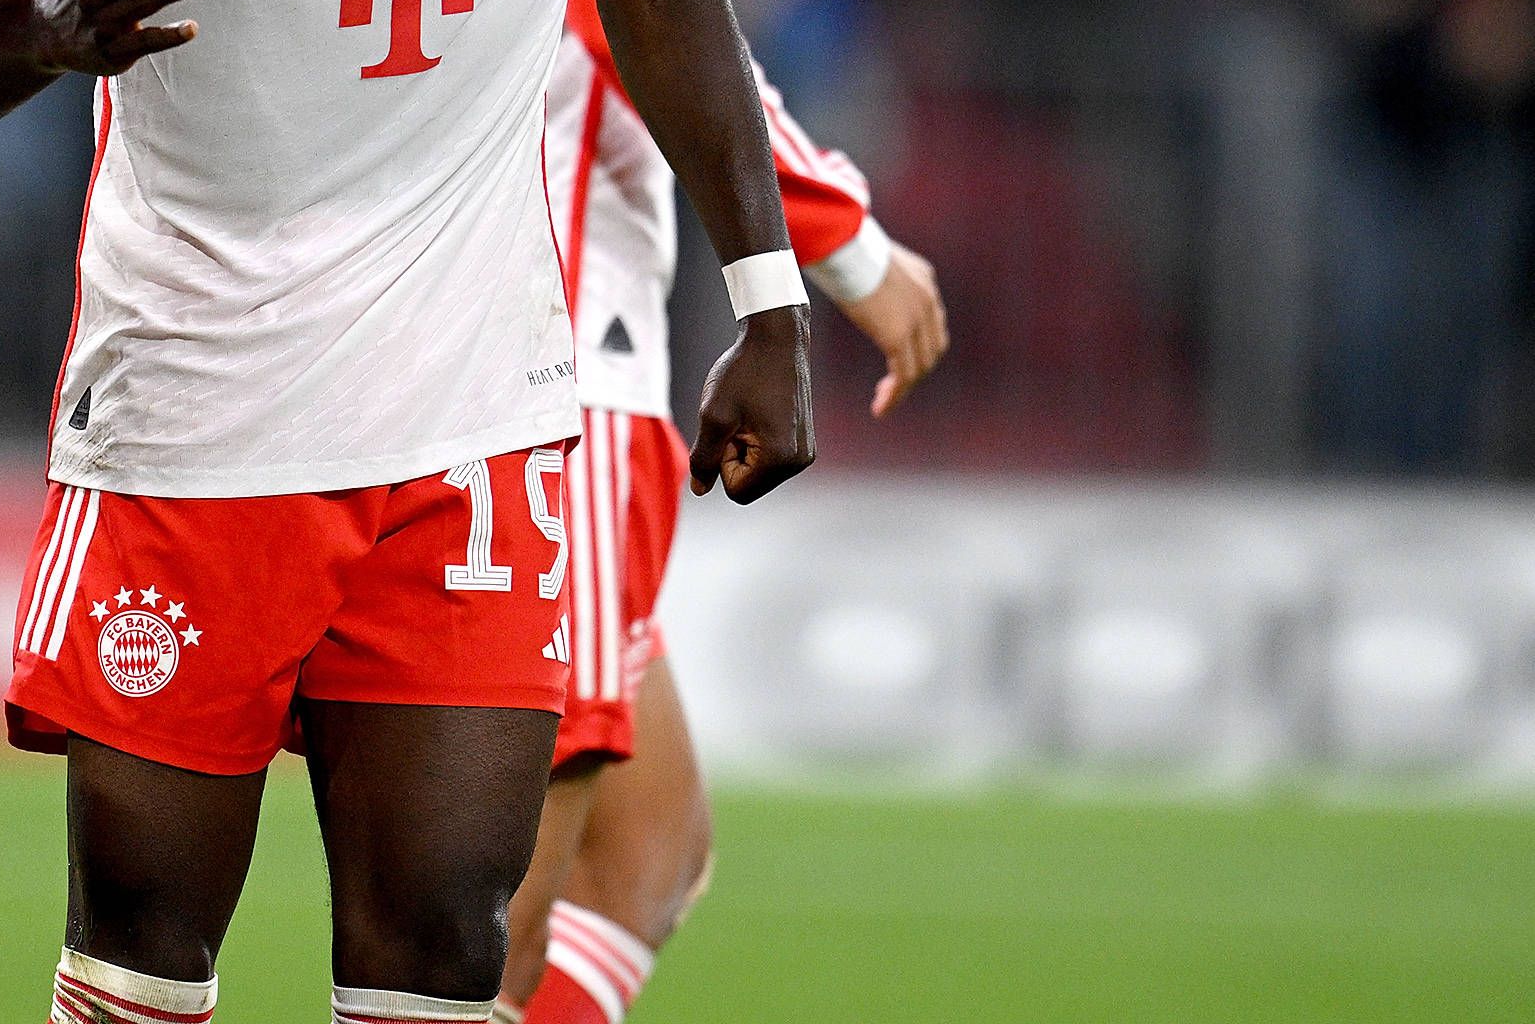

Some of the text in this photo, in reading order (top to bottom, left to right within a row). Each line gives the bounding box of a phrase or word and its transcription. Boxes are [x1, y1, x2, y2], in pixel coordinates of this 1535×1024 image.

[441, 448, 568, 600] 19
[107, 617, 172, 655] FC BAYERN
[103, 655, 166, 690] MÜNCHEN
